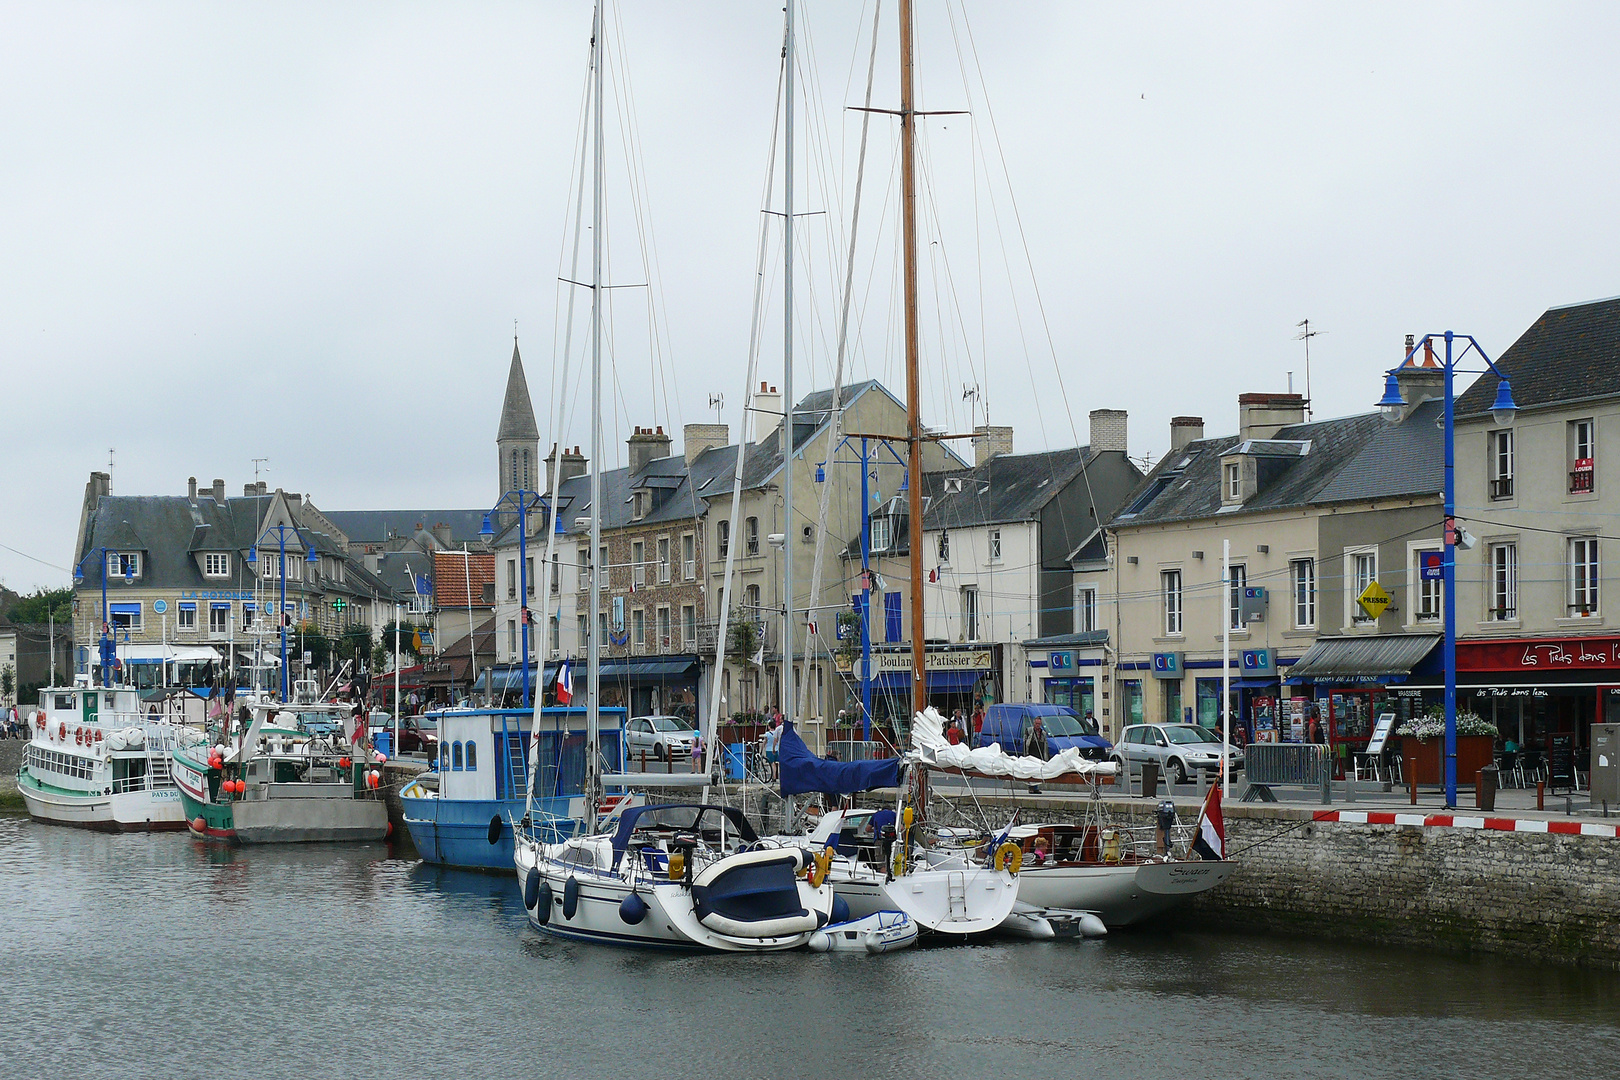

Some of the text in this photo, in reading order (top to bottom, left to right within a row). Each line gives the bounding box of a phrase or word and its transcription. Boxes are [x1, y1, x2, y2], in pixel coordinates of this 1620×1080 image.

[182, 590, 254, 600] LA ROTONDE
[1522, 646, 1538, 665] Les
[1535, 643, 1572, 664] Pieds
[1578, 642, 1606, 663] dans
[1053, 655, 1069, 666] CIC
[1156, 657, 1174, 668] CIC
[1246, 654, 1266, 666] CIC
[1511, 688, 1530, 696] dans
